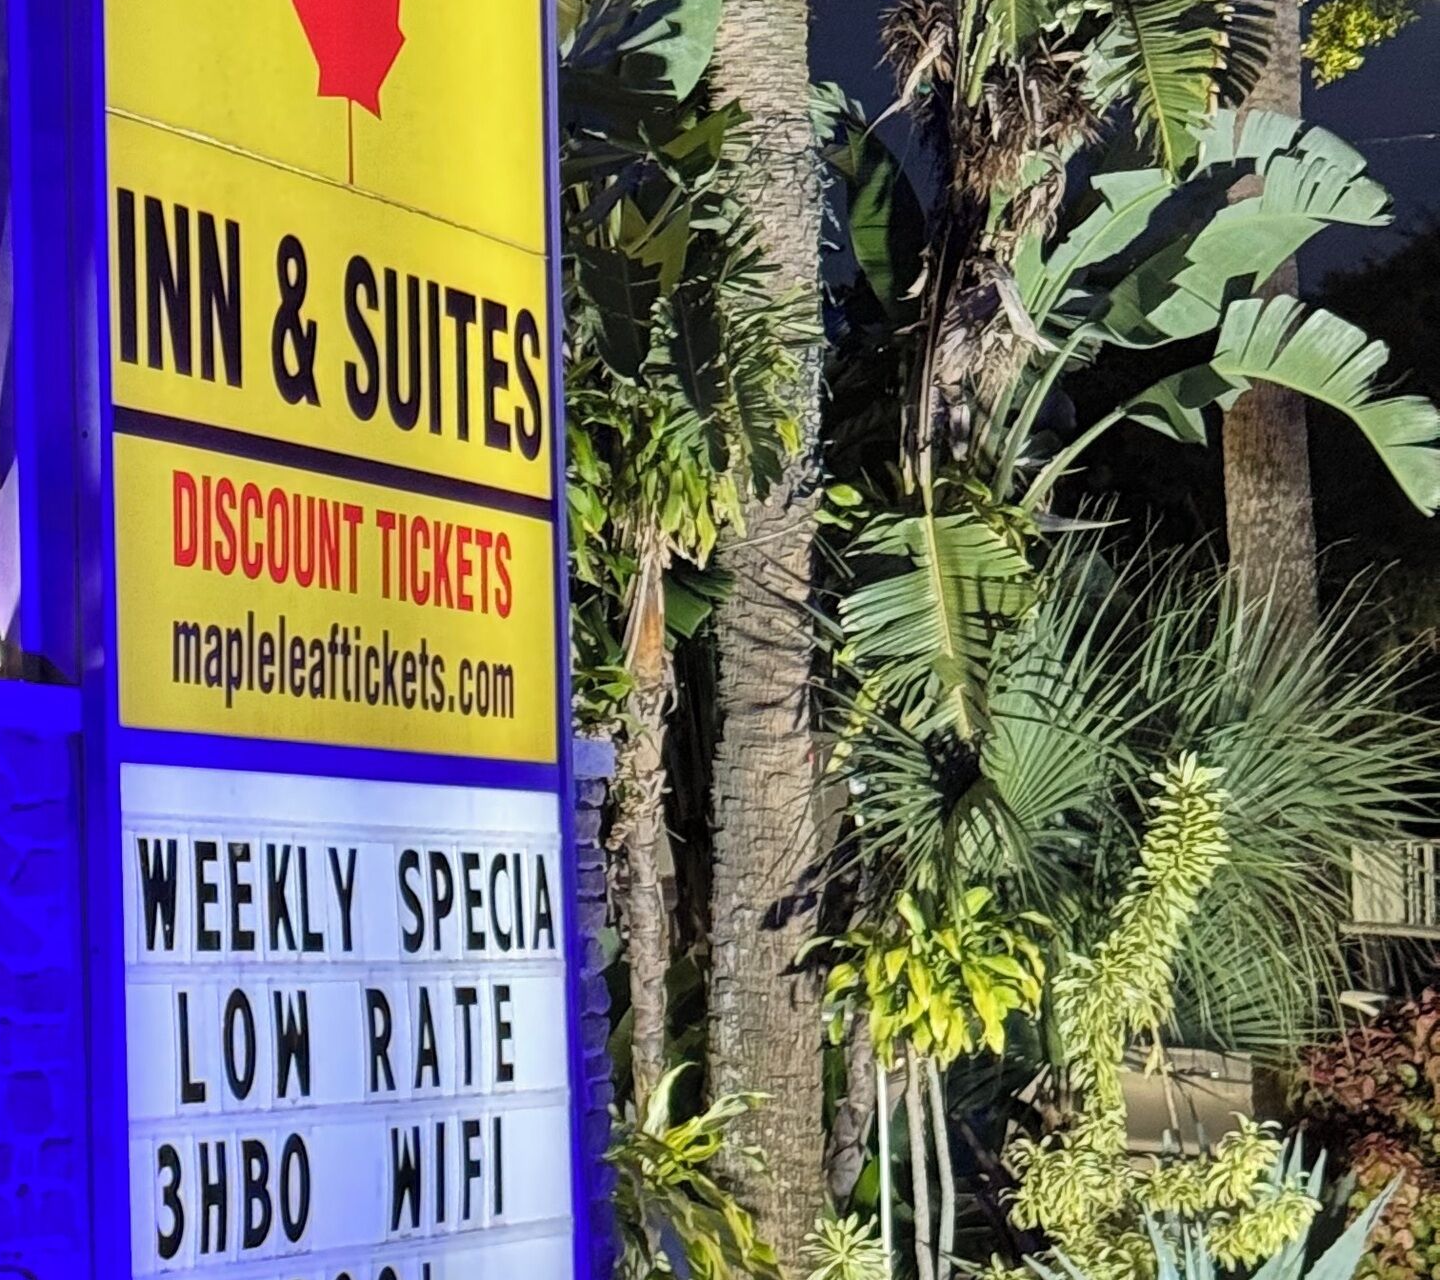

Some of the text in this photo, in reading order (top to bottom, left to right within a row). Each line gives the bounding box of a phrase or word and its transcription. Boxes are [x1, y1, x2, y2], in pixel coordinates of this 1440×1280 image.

[115, 186, 543, 462] INN & SUITES
[172, 468, 513, 619] DISCOUNT TICKETS
[172, 610, 515, 719] mapleleaftickets.com
[136, 837, 556, 954] WEEKLY SPECIA
[177, 984, 514, 1105] LOW RATE
[156, 1116, 504, 1260] 3HBO WIFI
